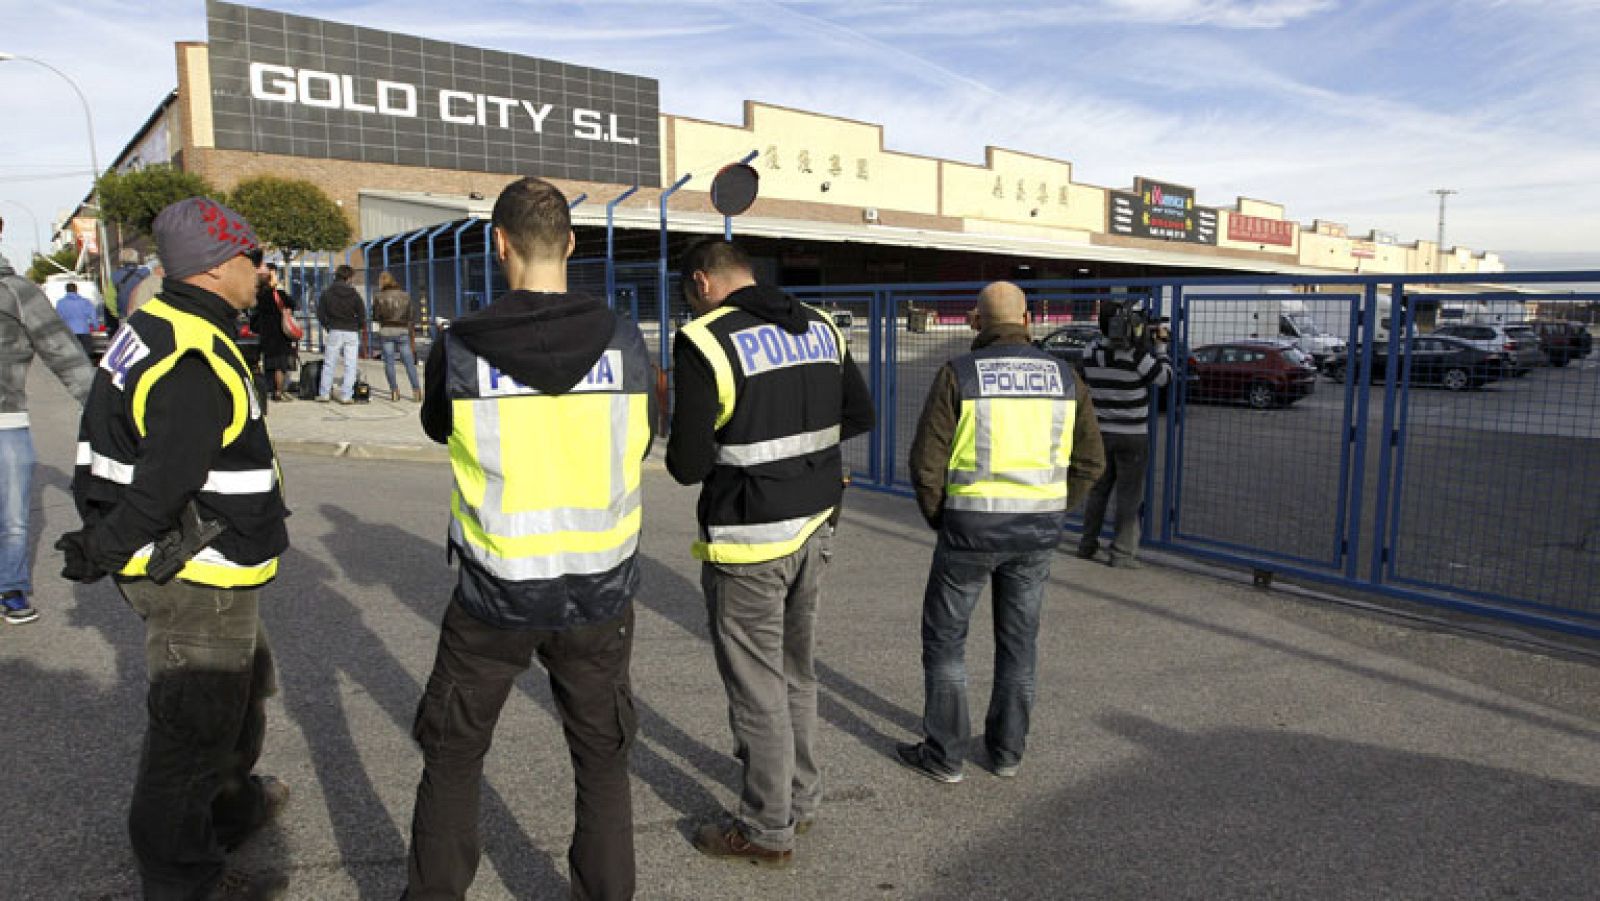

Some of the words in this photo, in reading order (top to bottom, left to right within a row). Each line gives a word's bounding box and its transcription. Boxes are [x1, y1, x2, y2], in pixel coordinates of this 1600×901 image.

[250, 62, 417, 118] GOLD
[439, 89, 553, 134] CITY
[573, 107, 640, 145] S.L.
